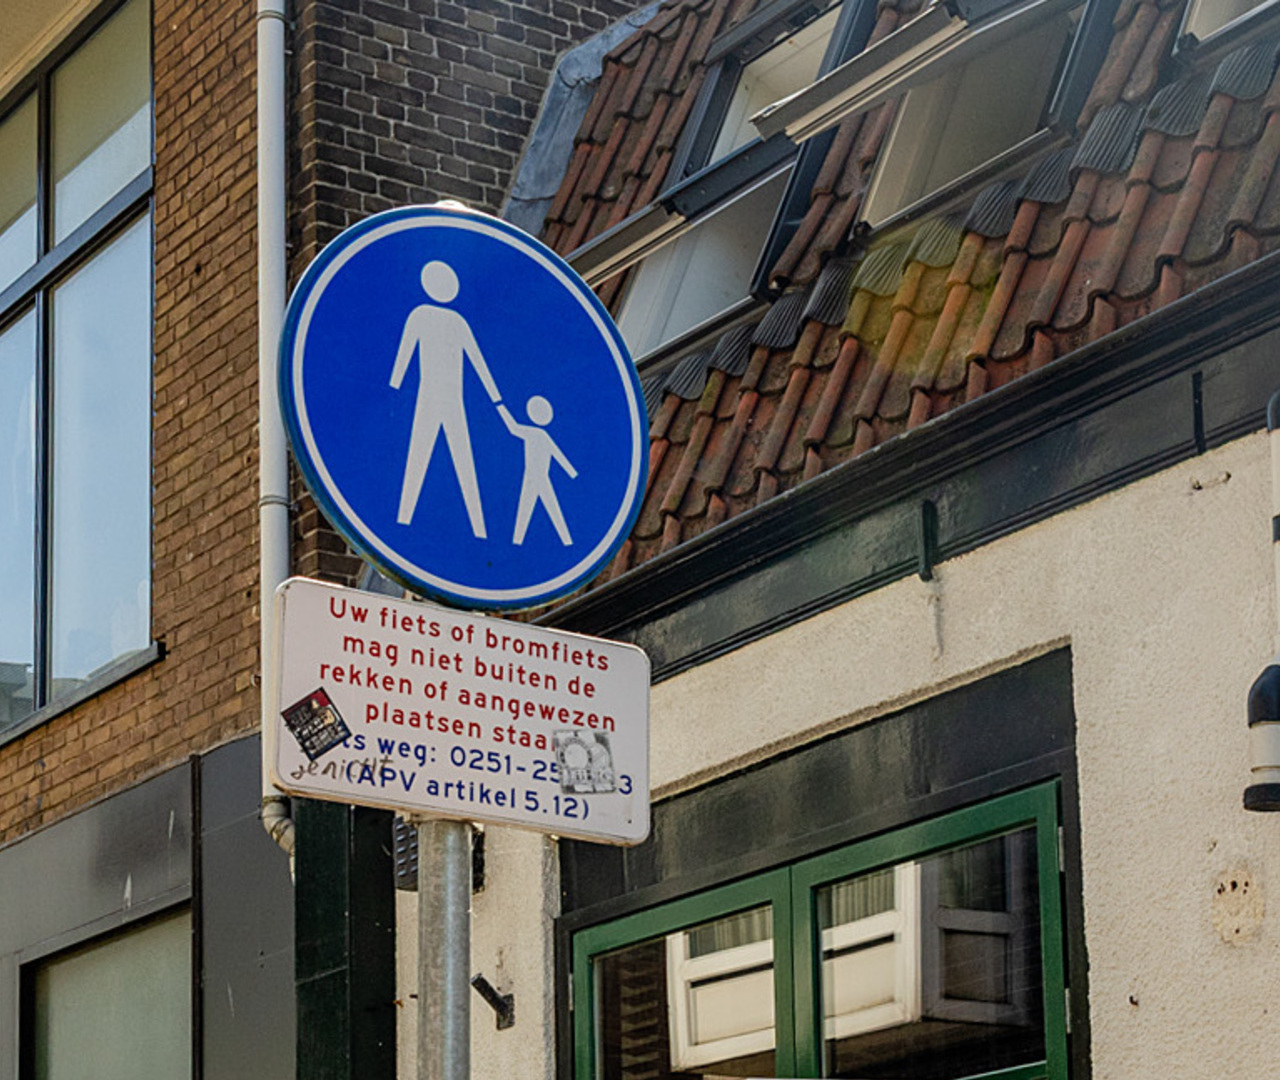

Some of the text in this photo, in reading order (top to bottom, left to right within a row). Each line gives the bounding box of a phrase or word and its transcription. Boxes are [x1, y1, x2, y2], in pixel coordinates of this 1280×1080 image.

[329, 596, 609, 671] Uw fiets of bromfiets
[342, 635, 596, 698] mag niet buiten de
[320, 663, 615, 732] rekken of aangewezen
[365, 701, 482, 738] plaatsen
[492, 725, 555, 751] staa
[346, 761, 590, 820] (APV artikel 5.12)
[378, 738, 438, 767] weg:
[450, 746, 633, 795] 0251-253
